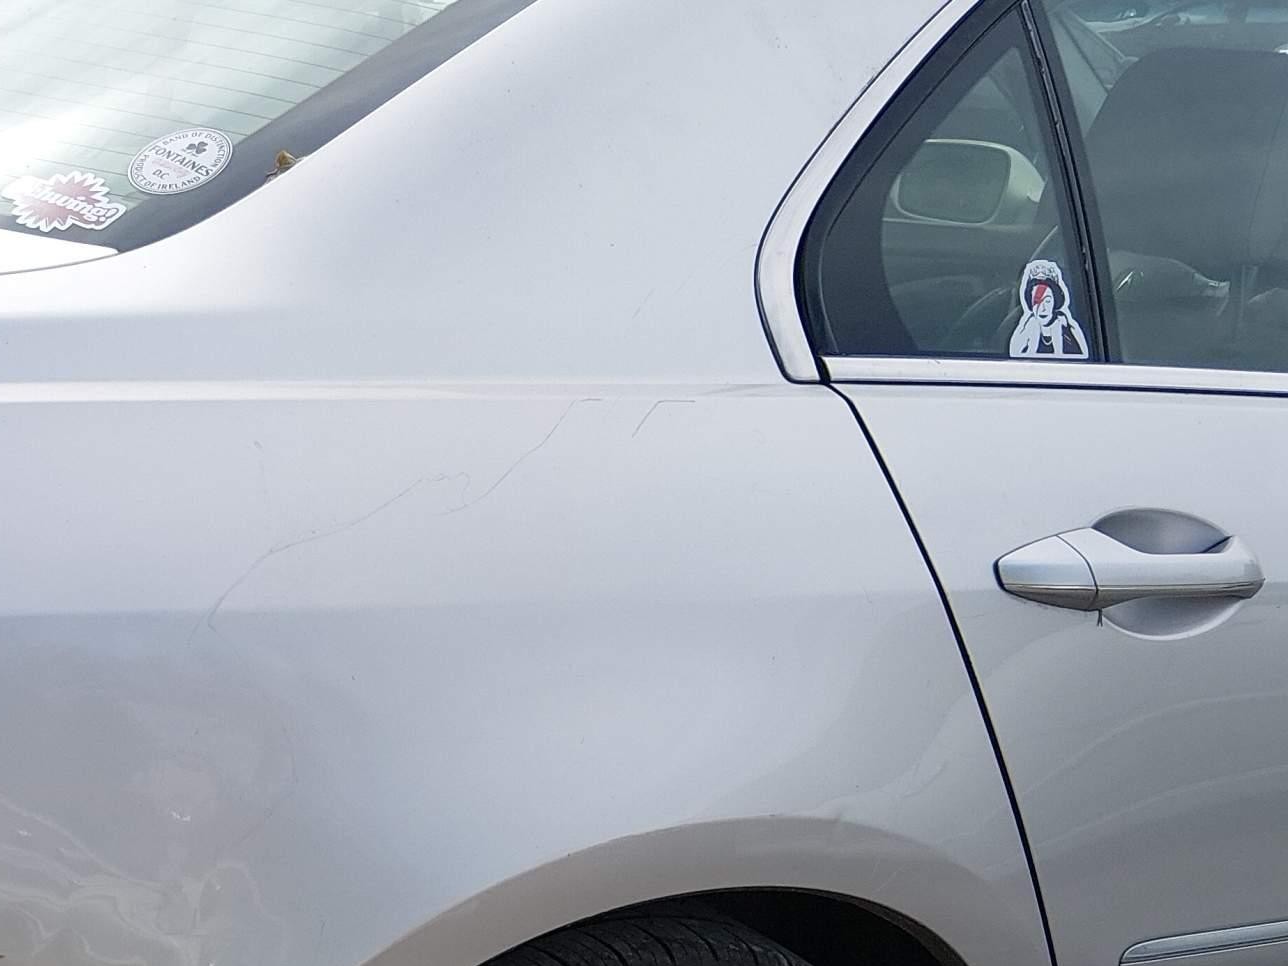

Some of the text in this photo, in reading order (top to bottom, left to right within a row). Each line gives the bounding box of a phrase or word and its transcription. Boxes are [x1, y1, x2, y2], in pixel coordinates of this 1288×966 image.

[149, 145, 213, 177] FONTAINES
[162, 134, 189, 146] BAND
[204, 131, 226, 168] DISTINCTION
[157, 176, 201, 190] IRELAND
